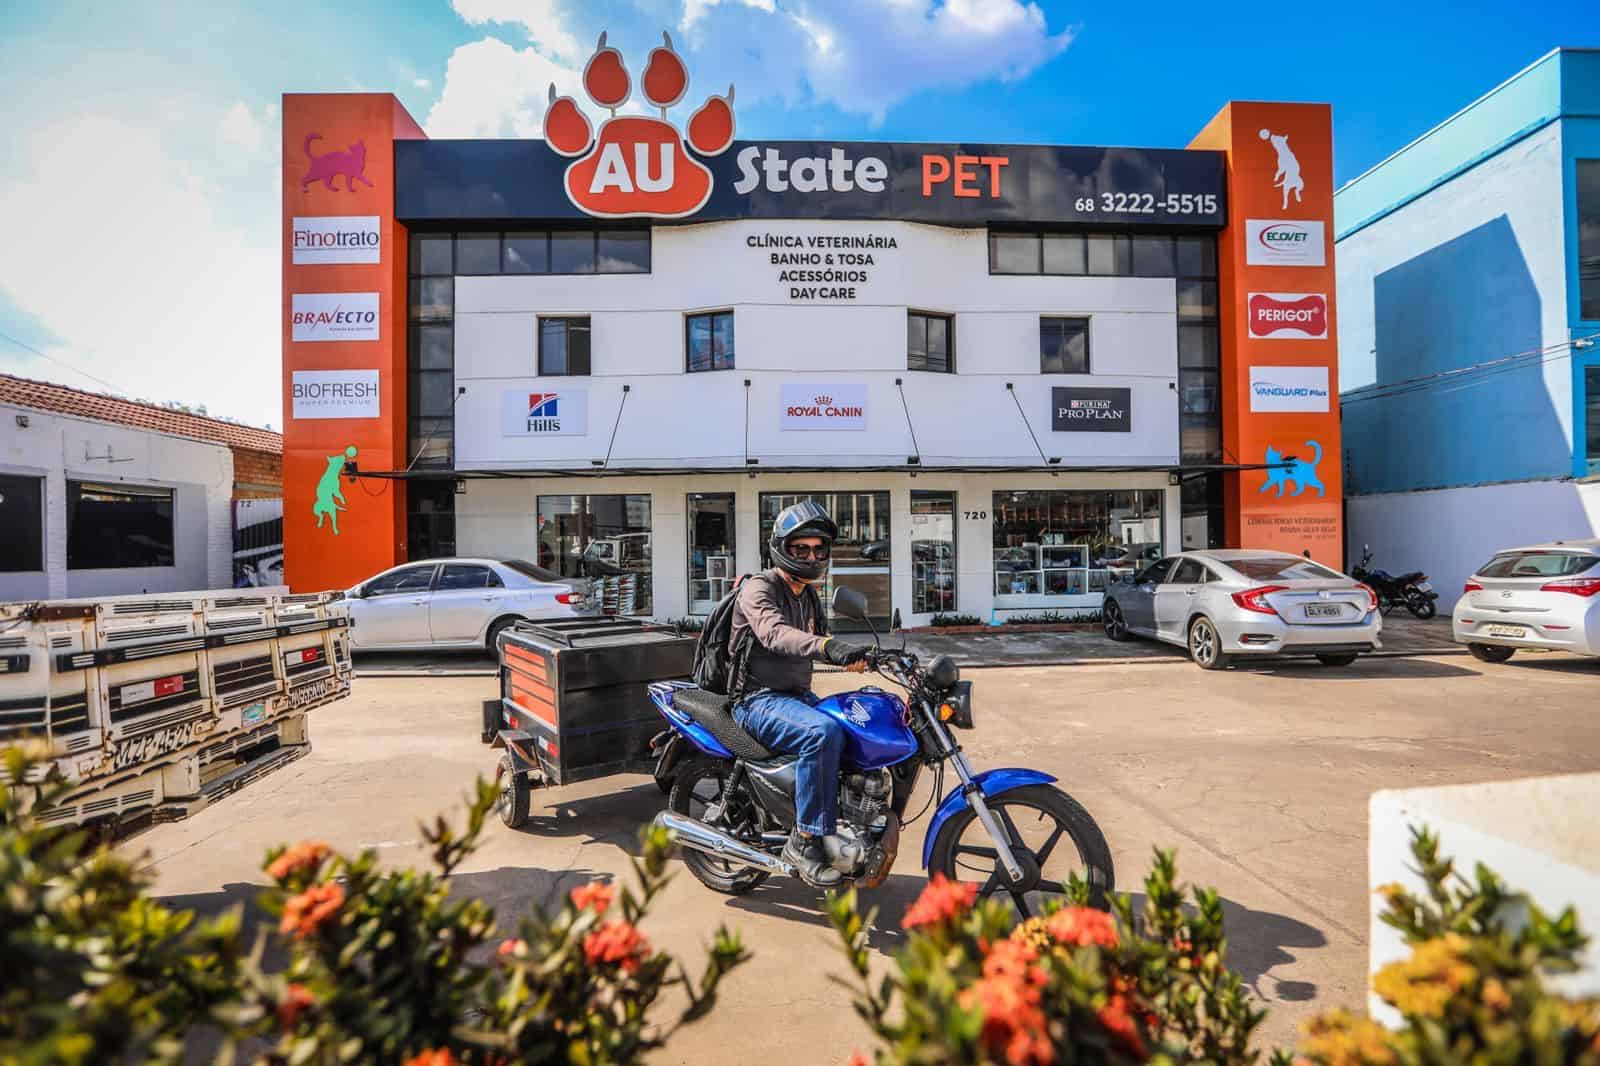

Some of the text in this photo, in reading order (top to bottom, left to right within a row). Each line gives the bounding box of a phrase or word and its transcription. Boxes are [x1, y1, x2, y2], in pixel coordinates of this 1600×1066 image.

[589, 143, 1009, 198] AU State PET
[1074, 192, 1217, 214] 68 3222-5515
[294, 230, 379, 247] Finotrato
[746, 233, 898, 248] CLÍNICA VETERINÁRIA
[1266, 232, 1308, 242] ECOVET
[770, 253, 874, 265] BANHO & TOSA
[778, 268, 868, 282] ACESSÓRIOS
[790, 287, 857, 299] DAY CARE
[293, 306, 375, 327] BRAVECTO
[1258, 308, 1312, 322] PERIGOT
[293, 383, 377, 398] BIOFRESH
[1254, 387, 1308, 397] VANGUARD
[787, 407, 863, 417] ROYAL CANIN
[527, 418, 561, 432] Hill's
[963, 511, 987, 520] 720
